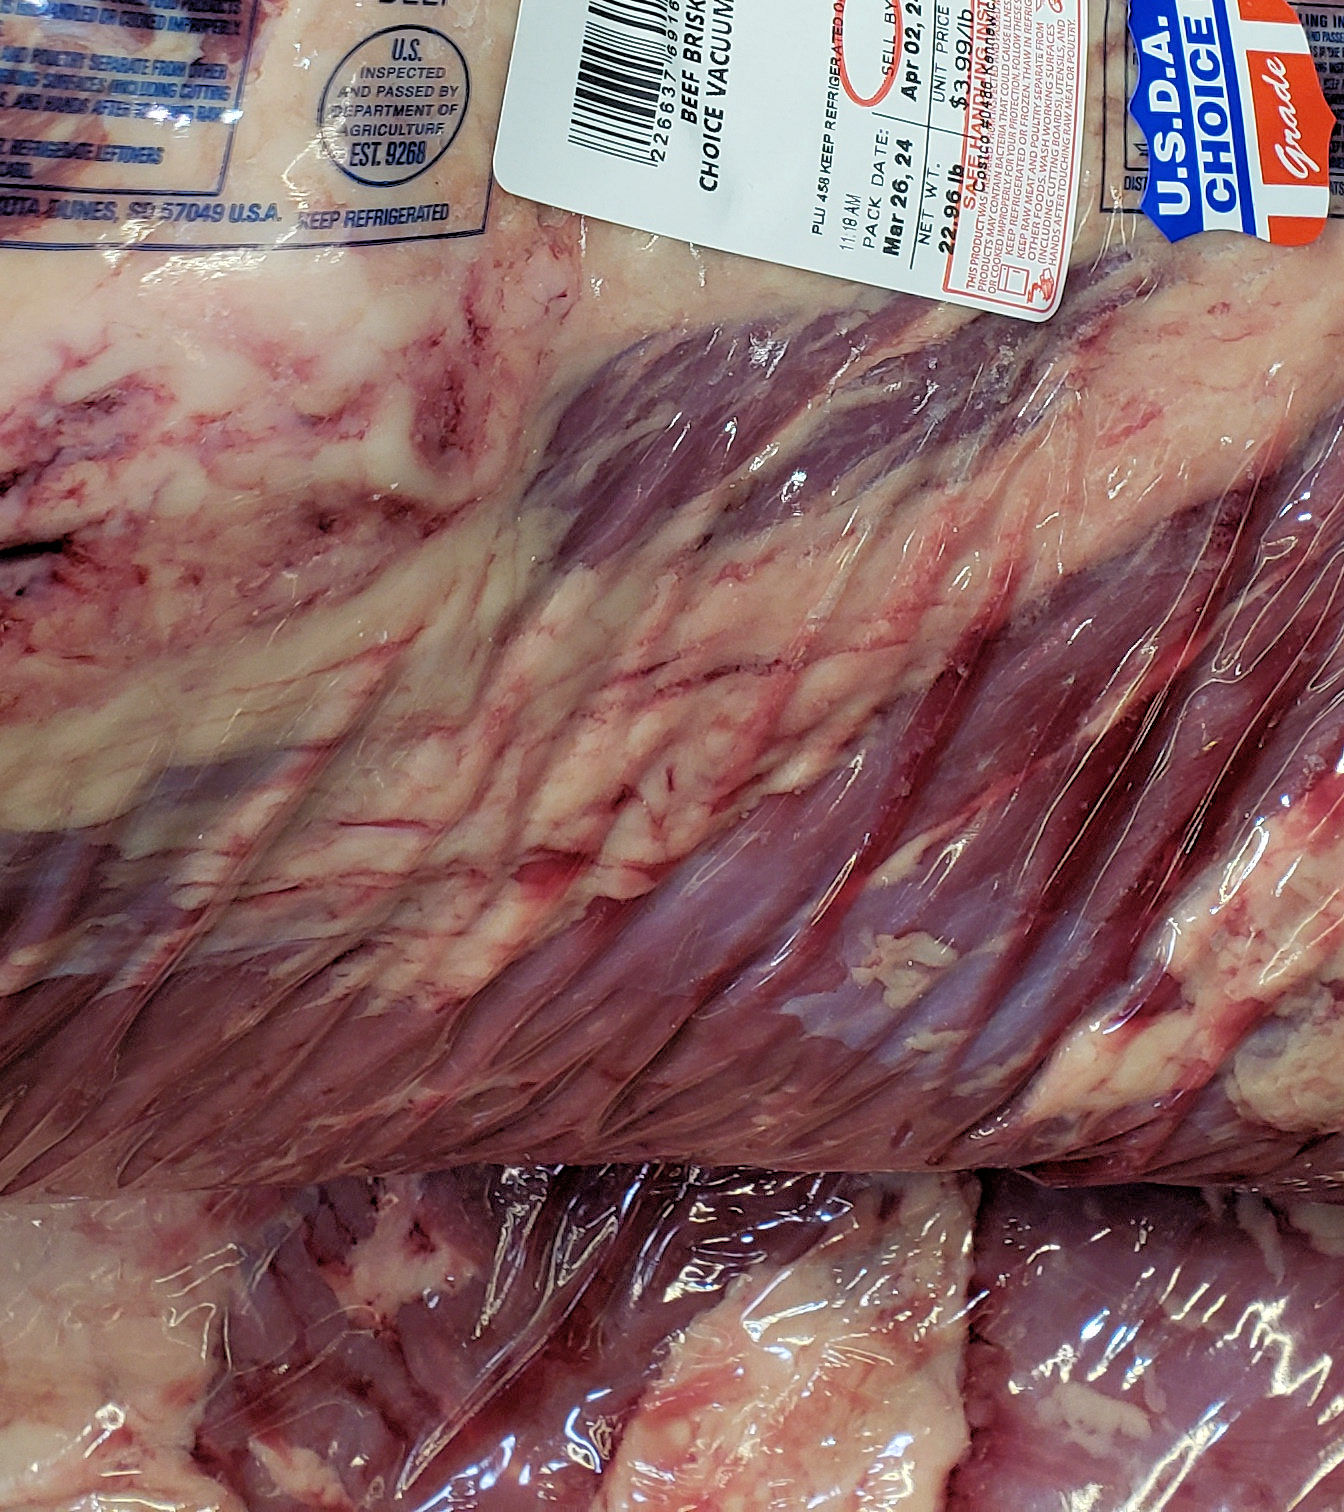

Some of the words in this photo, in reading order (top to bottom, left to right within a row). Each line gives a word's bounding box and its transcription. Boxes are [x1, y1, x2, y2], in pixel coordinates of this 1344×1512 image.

[391, 38, 423, 62] U.S.
[903, 22, 925, 55] 02,
[936, 4, 951, 54] PRICE
[1035, 20, 1043, 51] FROM
[359, 66, 446, 80] INSPECTED
[824, 16, 844, 130] REFRIGERATED
[881, 34, 896, 76] SELL
[948, 8, 974, 110] $3.99/lb
[1034, 51, 1043, 101] SEPARATE
[375, 85, 436, 98] PASSED
[438, 85, 460, 98] BY
[679, 68, 700, 125] BEEF
[900, 58, 922, 102] Apr
[932, 61, 947, 103] UNIT
[968, 45, 986, 150] HANDLING
[330, 104, 435, 118] DEPARTMENT
[437, 103, 459, 117] OF
[651, 69, 678, 162] 226637
[978, 80, 993, 129] #0486
[1030, 101, 1041, 148] POULTRY
[1142, 15, 1191, 216] U.S.D.A.
[1184, 16, 1237, 214] CHOICE
[1261, 55, 1320, 179] Grade
[349, 142, 381, 167] EST.
[384, 140, 426, 166] 9268
[698, 104, 724, 192] CHOICE
[819, 132, 834, 174] KEEP
[870, 128, 889, 187] DATE:
[894, 138, 913, 167] 24
[972, 134, 990, 192] Costco
[1028, 149, 1037, 174] AND
[816, 176, 830, 202] 458
[889, 173, 914, 209] 26,
[923, 162, 941, 198] WT.
[946, 163, 965, 184] lb
[963, 154, 978, 210] SAFE
[1024, 175, 1034, 205] MEAT
[159, 199, 226, 225] 57049
[227, 200, 284, 225] U.S.A.
[344, 202, 450, 229] REFRIGERATED
[811, 206, 826, 235] PLU
[842, 192, 862, 217] AM
[861, 195, 882, 249] PACK
[917, 206, 934, 245] NET
[937, 188, 962, 255] 22.96
[1020, 205, 1030, 231] RAW
[882, 212, 905, 256] Mar
[1017, 232, 1027, 259] KEEP
